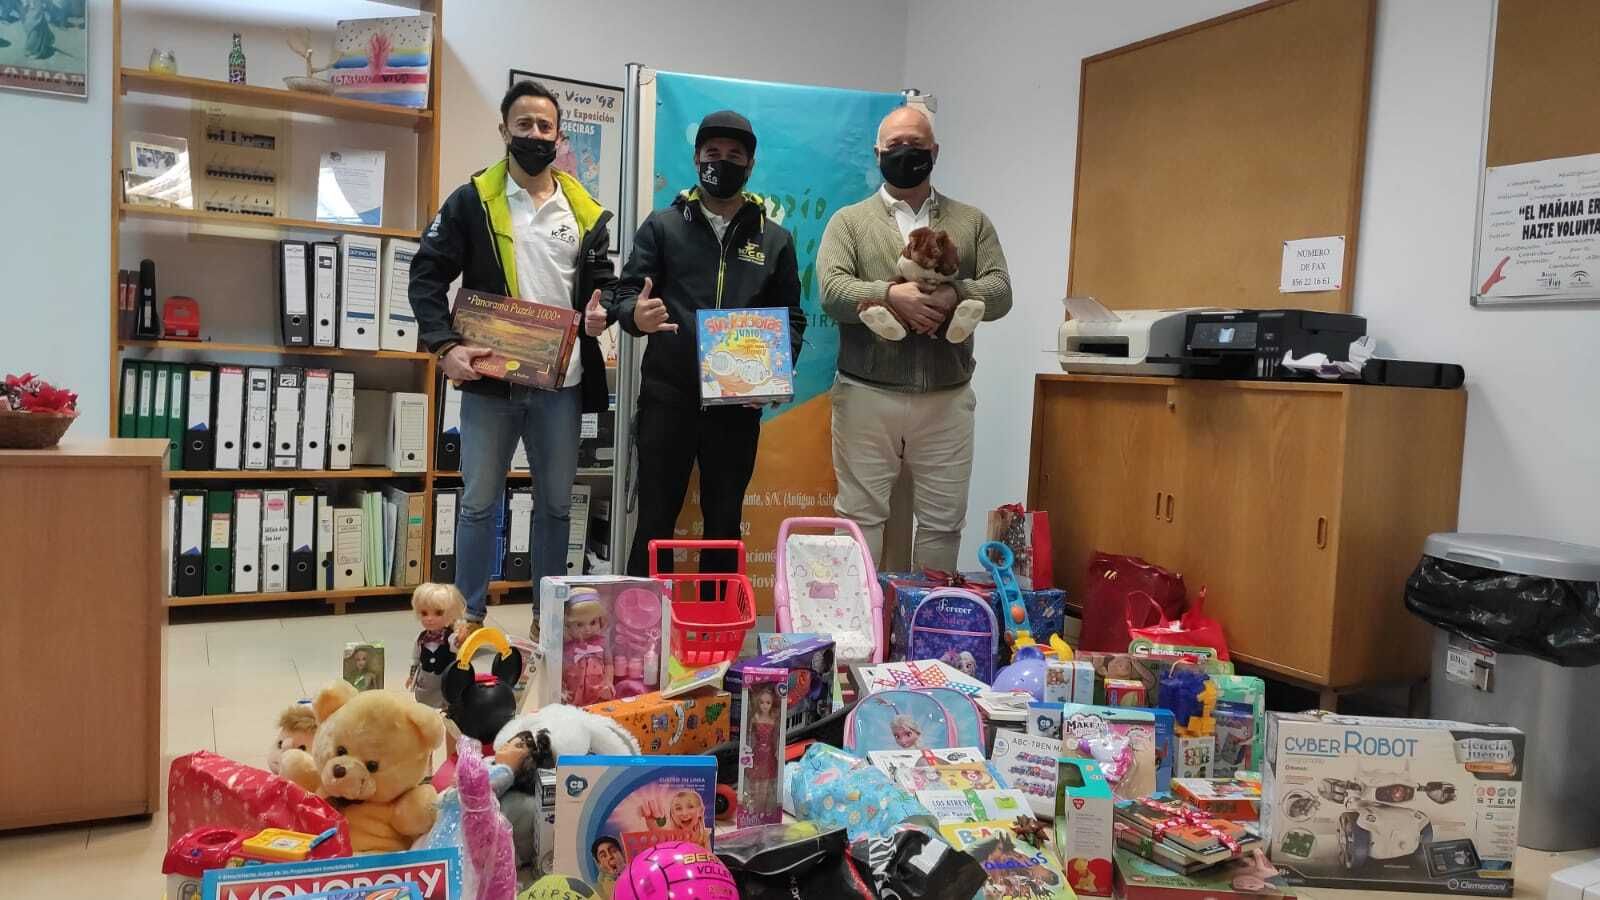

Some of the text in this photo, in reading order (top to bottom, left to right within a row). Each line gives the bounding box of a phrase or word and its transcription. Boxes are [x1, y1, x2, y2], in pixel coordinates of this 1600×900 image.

[565, 88, 592, 104] Vivo
[574, 108, 615, 124] Exposición
[561, 122, 596, 135] GECIRAS
[1539, 199, 1584, 219] MAÑANA
[1588, 198, 1600, 215] ER
[1522, 219, 1600, 240] HAZTE VOLUNTA
[1311, 262, 1326, 271] FAX
[469, 294, 509, 312] Panorama
[510, 302, 535, 316] Puzzle
[1284, 731, 1418, 757] CYBER ROBOT
